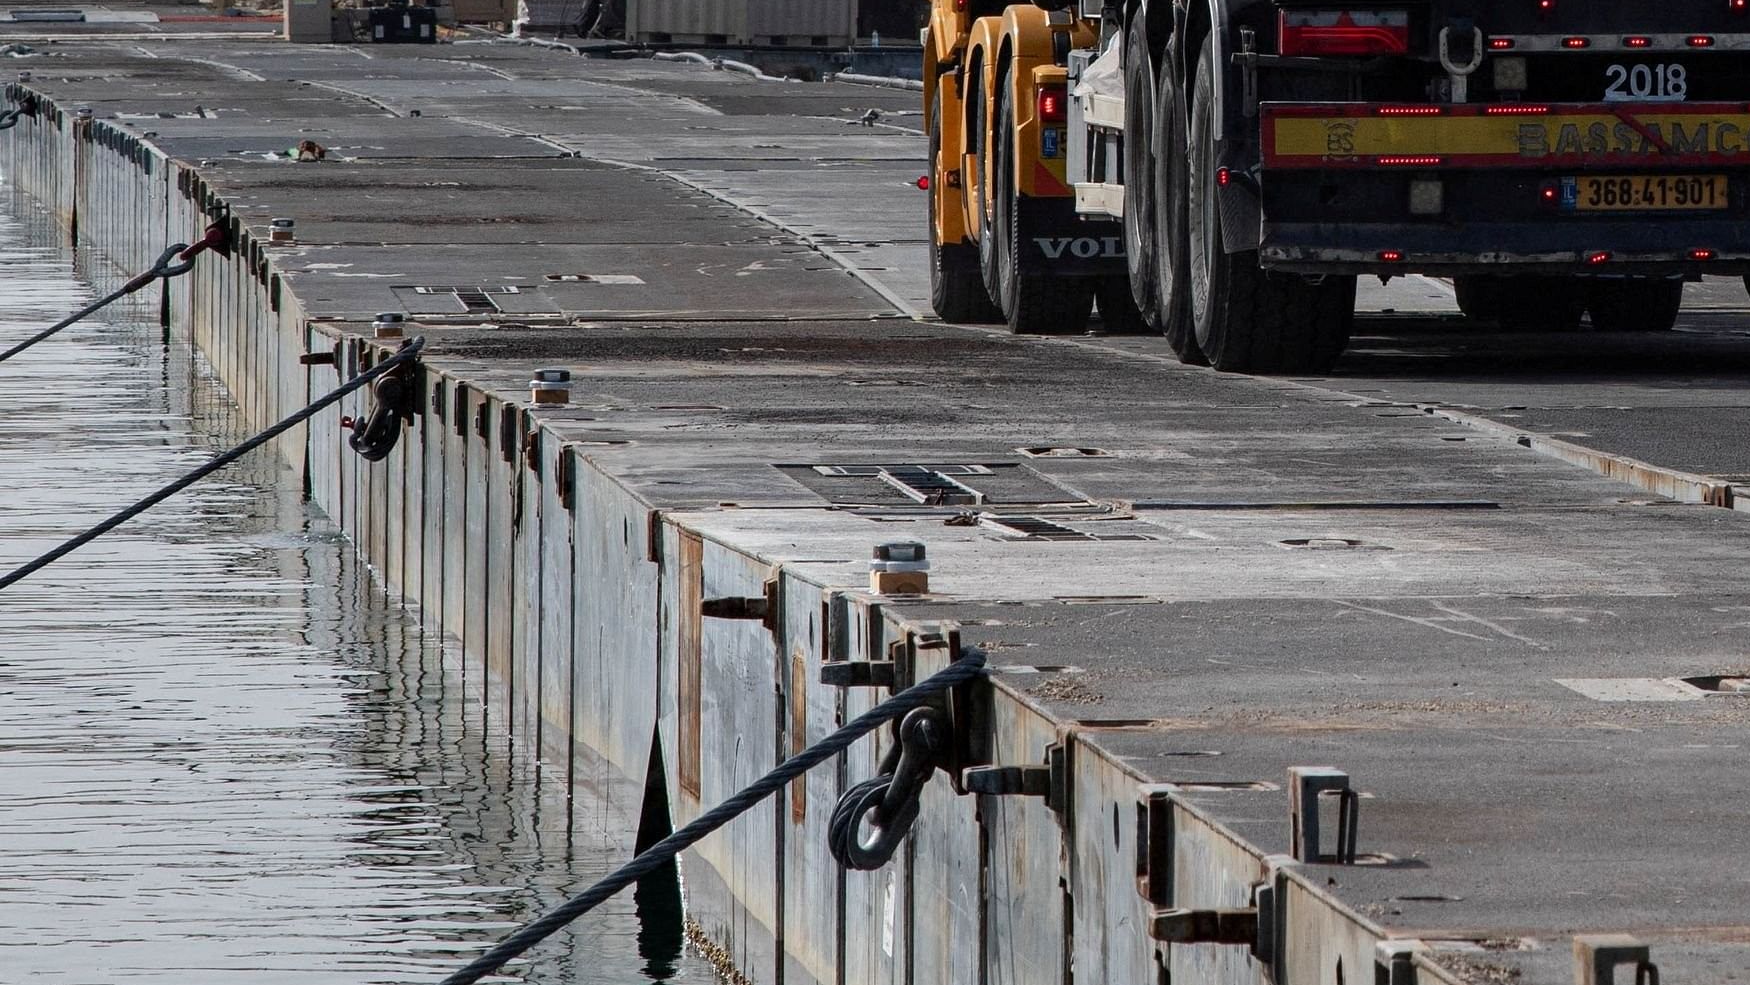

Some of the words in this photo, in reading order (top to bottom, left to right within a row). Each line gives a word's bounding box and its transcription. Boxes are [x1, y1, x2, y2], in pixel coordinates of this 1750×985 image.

[1604, 63, 1687, 97] 2018
[1046, 137, 1055, 149] IL
[1563, 185, 1574, 199] IL
